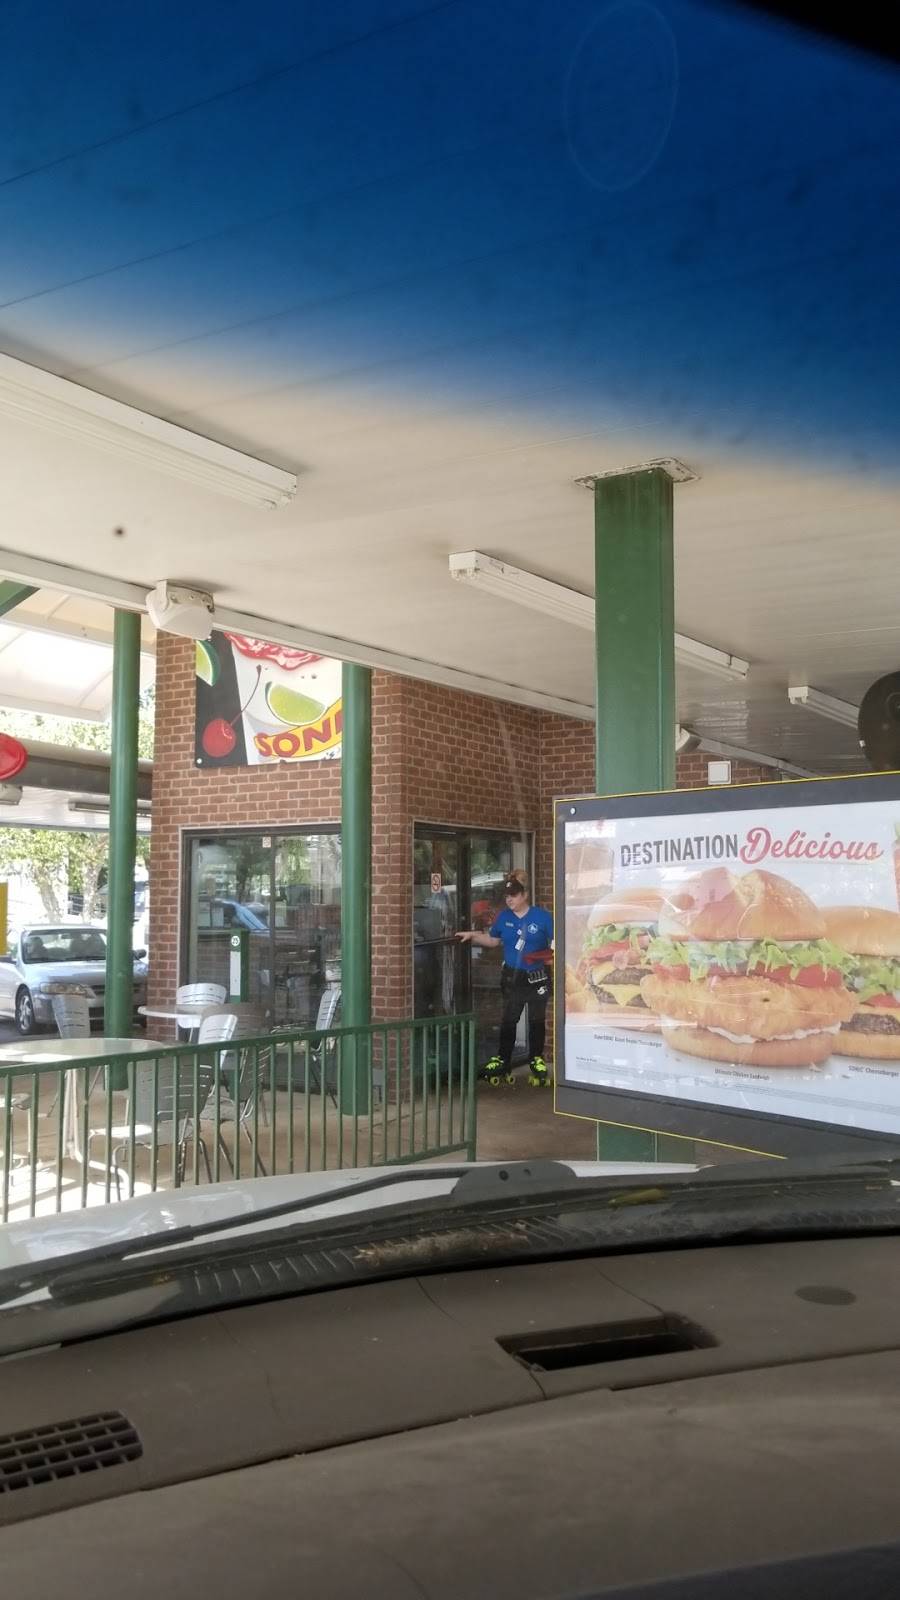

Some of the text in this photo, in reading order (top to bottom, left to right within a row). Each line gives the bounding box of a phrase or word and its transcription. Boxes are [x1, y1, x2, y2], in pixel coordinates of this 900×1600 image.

[256, 709, 342, 758] SONI
[621, 827, 884, 867] DESTINATION Delicious
